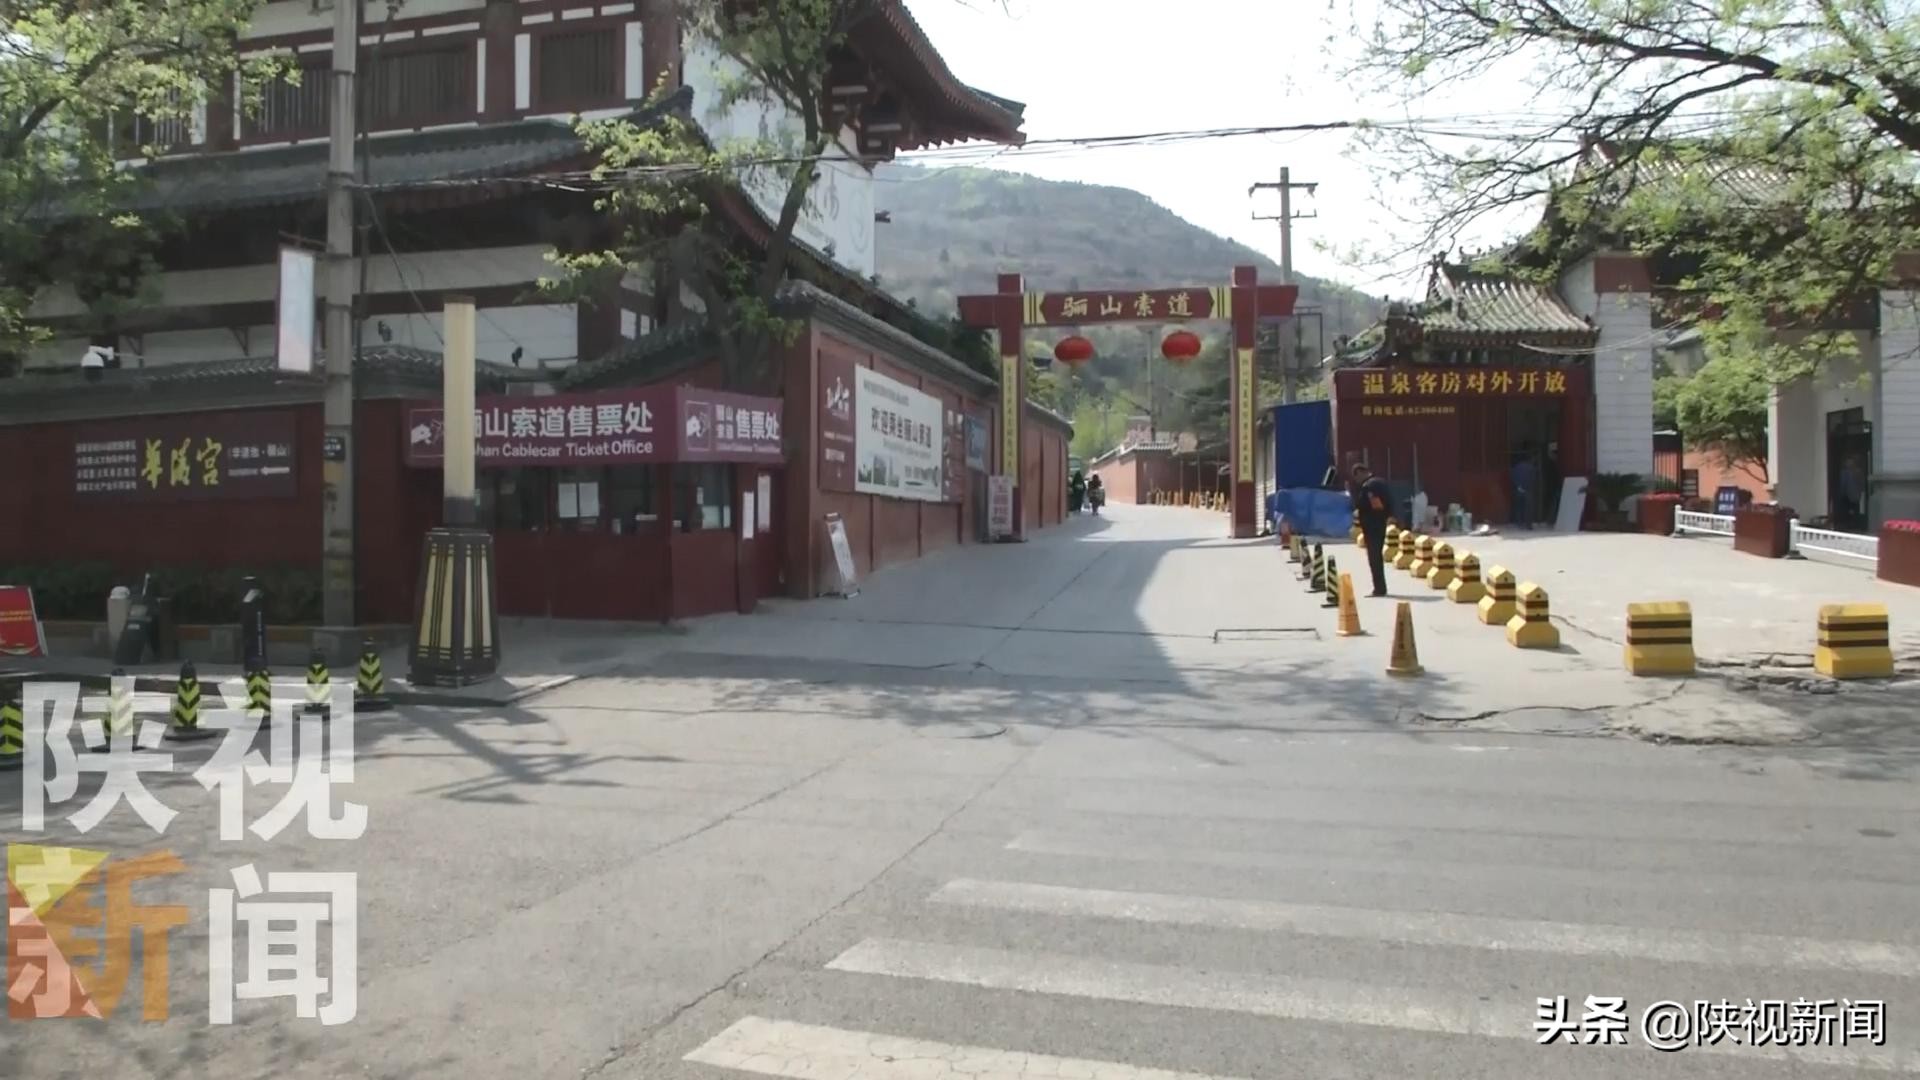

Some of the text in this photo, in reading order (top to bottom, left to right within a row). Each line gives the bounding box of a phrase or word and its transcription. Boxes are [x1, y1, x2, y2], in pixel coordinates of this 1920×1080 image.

[1060, 291, 1193, 319] 骊山索道
[1362, 370, 1567, 395] 温泉客房对外开放
[736, 408, 780, 440] 售票处
[502, 441, 562, 457] Cablecar
[566, 441, 610, 457] Ticket
[611, 439, 653, 456] Office
